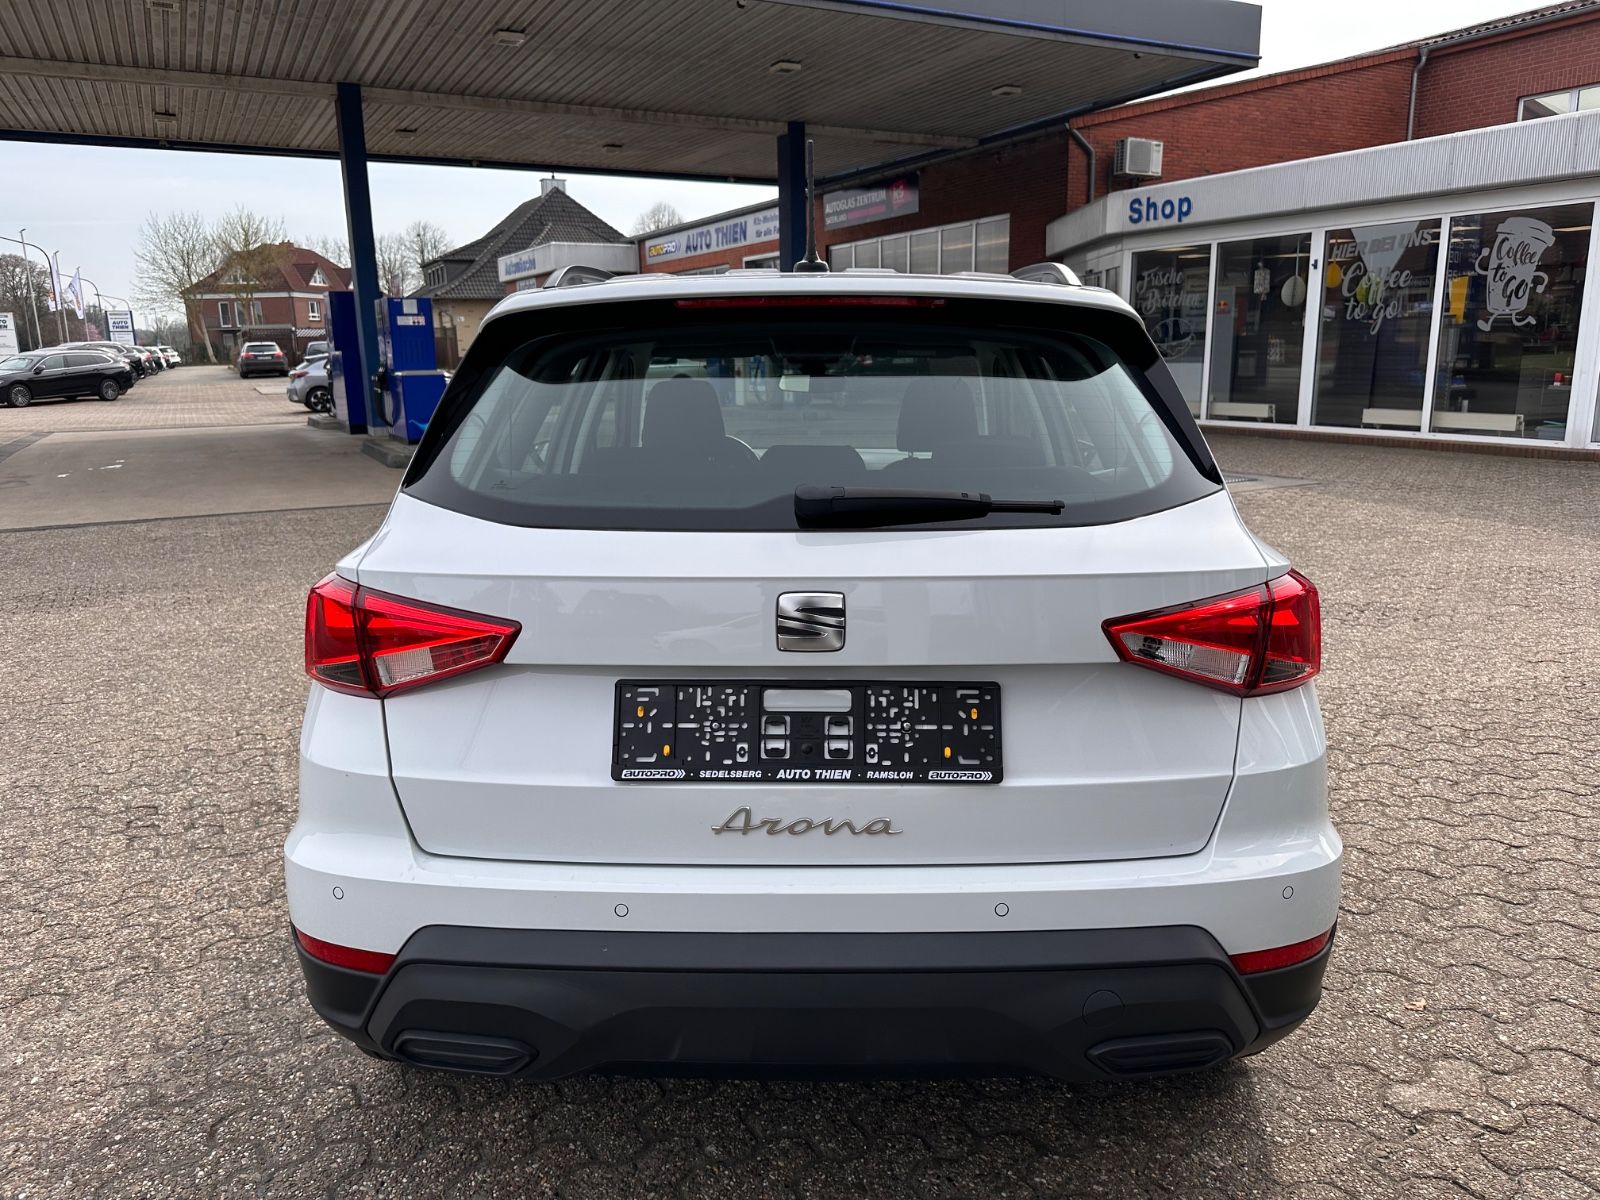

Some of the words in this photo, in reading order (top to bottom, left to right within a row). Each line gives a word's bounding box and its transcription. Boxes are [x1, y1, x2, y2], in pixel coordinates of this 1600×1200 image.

[825, 197, 856, 214] AUTOGLAS
[857, 188, 887, 207] ZENTRUM
[1128, 196, 1192, 224] Shop
[685, 229, 712, 254] AUTO
[715, 220, 748, 248] THIEN
[1331, 241, 1368, 259] HIER
[1368, 235, 1397, 255] BEI
[1397, 228, 1432, 249] UNS
[1496, 236, 1537, 267] Coffee
[1136, 267, 1184, 295] Frische
[1342, 261, 1413, 306] Coffee
[1490, 262, 1507, 284] to
[1344, 297, 1367, 321] to
[699, 770, 762, 778] SEDELSBERG
[776, 769, 811, 779] AUTO
[814, 769, 852, 779] THIEN
[866, 771, 914, 779] RAMSLOH
[711, 805, 904, 836] Arona
